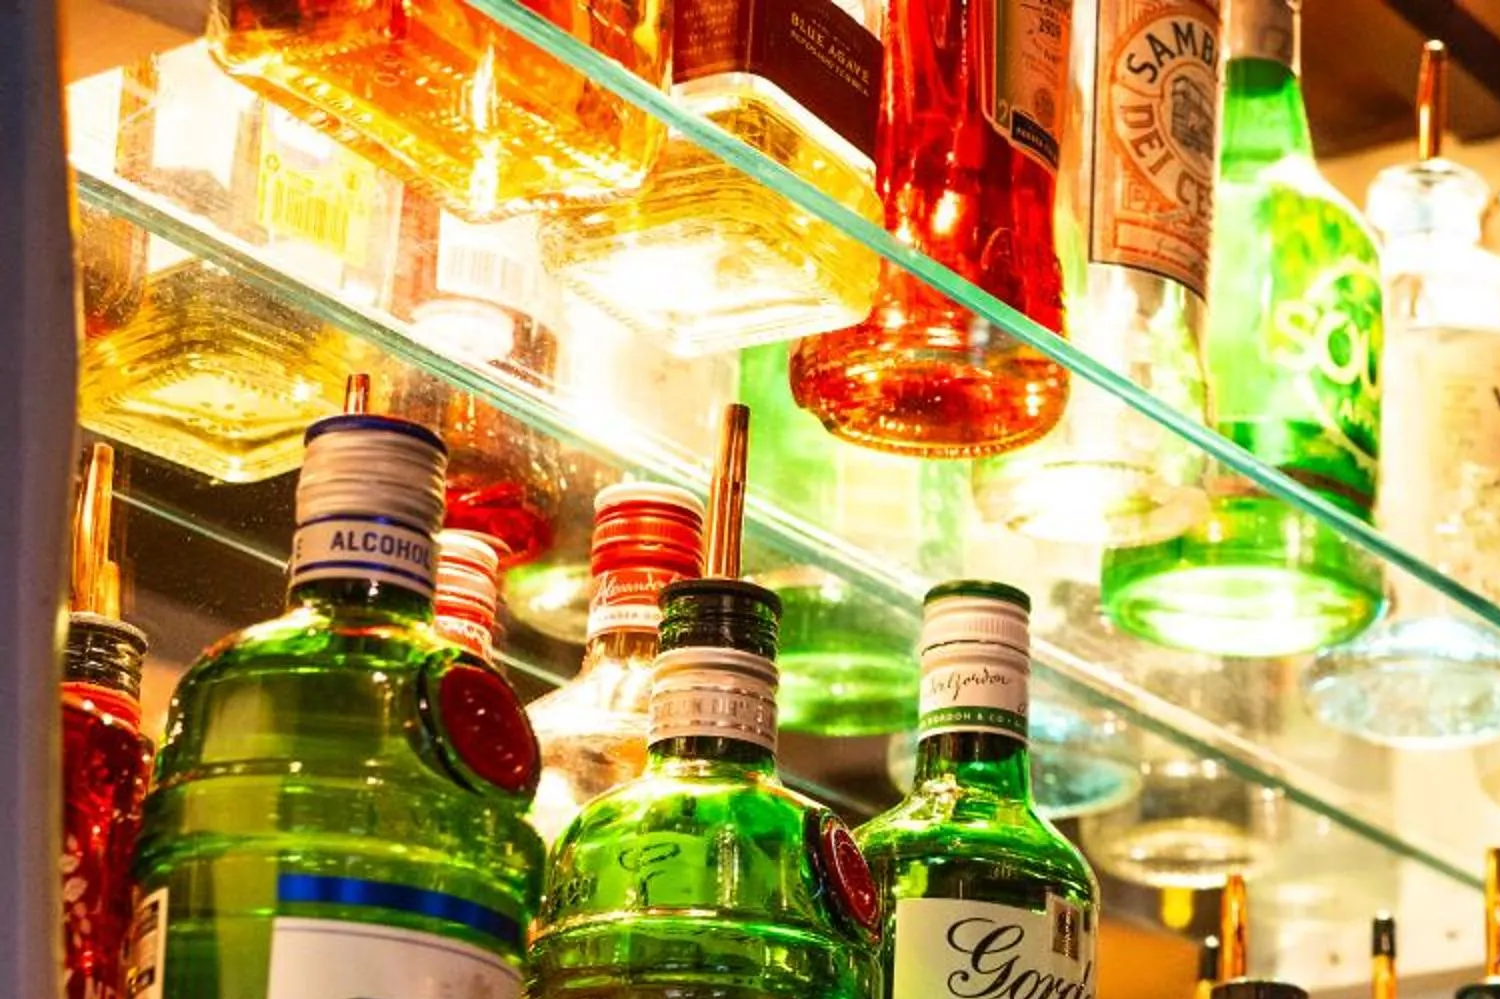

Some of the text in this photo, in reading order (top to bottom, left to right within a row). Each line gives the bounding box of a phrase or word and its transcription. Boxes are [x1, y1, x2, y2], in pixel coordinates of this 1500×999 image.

[790, 11, 871, 84] BLUE AGAVE
[1120, 105, 1174, 176] DEI
